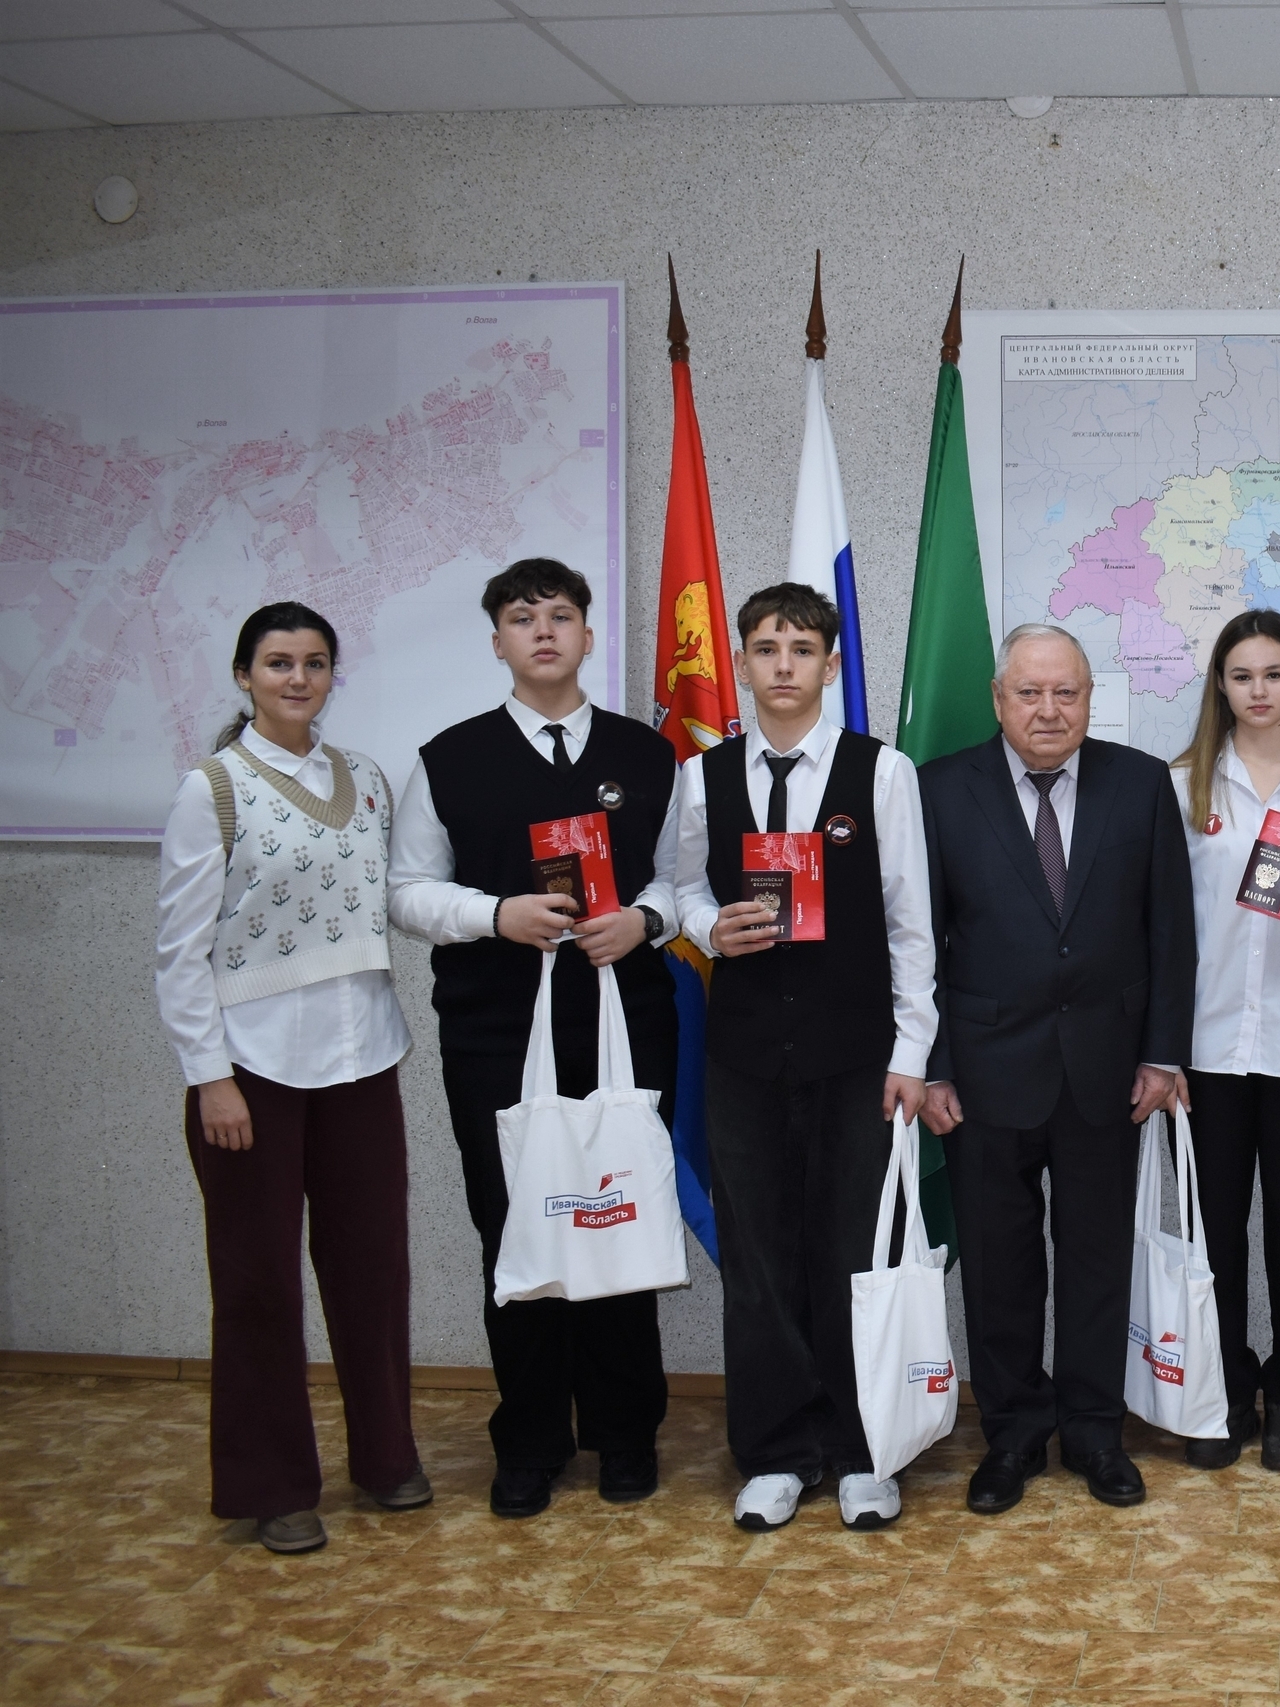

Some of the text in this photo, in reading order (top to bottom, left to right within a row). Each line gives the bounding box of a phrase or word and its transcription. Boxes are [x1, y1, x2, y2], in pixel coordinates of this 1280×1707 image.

[610, 325, 617, 333] A
[1145, 368, 1185, 377] ДЕЛЕНИЯ
[610, 403, 617, 412] B
[610, 481, 616, 490] C
[610, 560, 616, 568] D
[610, 637, 615, 646] E
[1244, 890, 1276, 906] ПАСПОРТ
[552, 1198, 617, 1211] Ивановская
[582, 1210, 628, 1225] область
